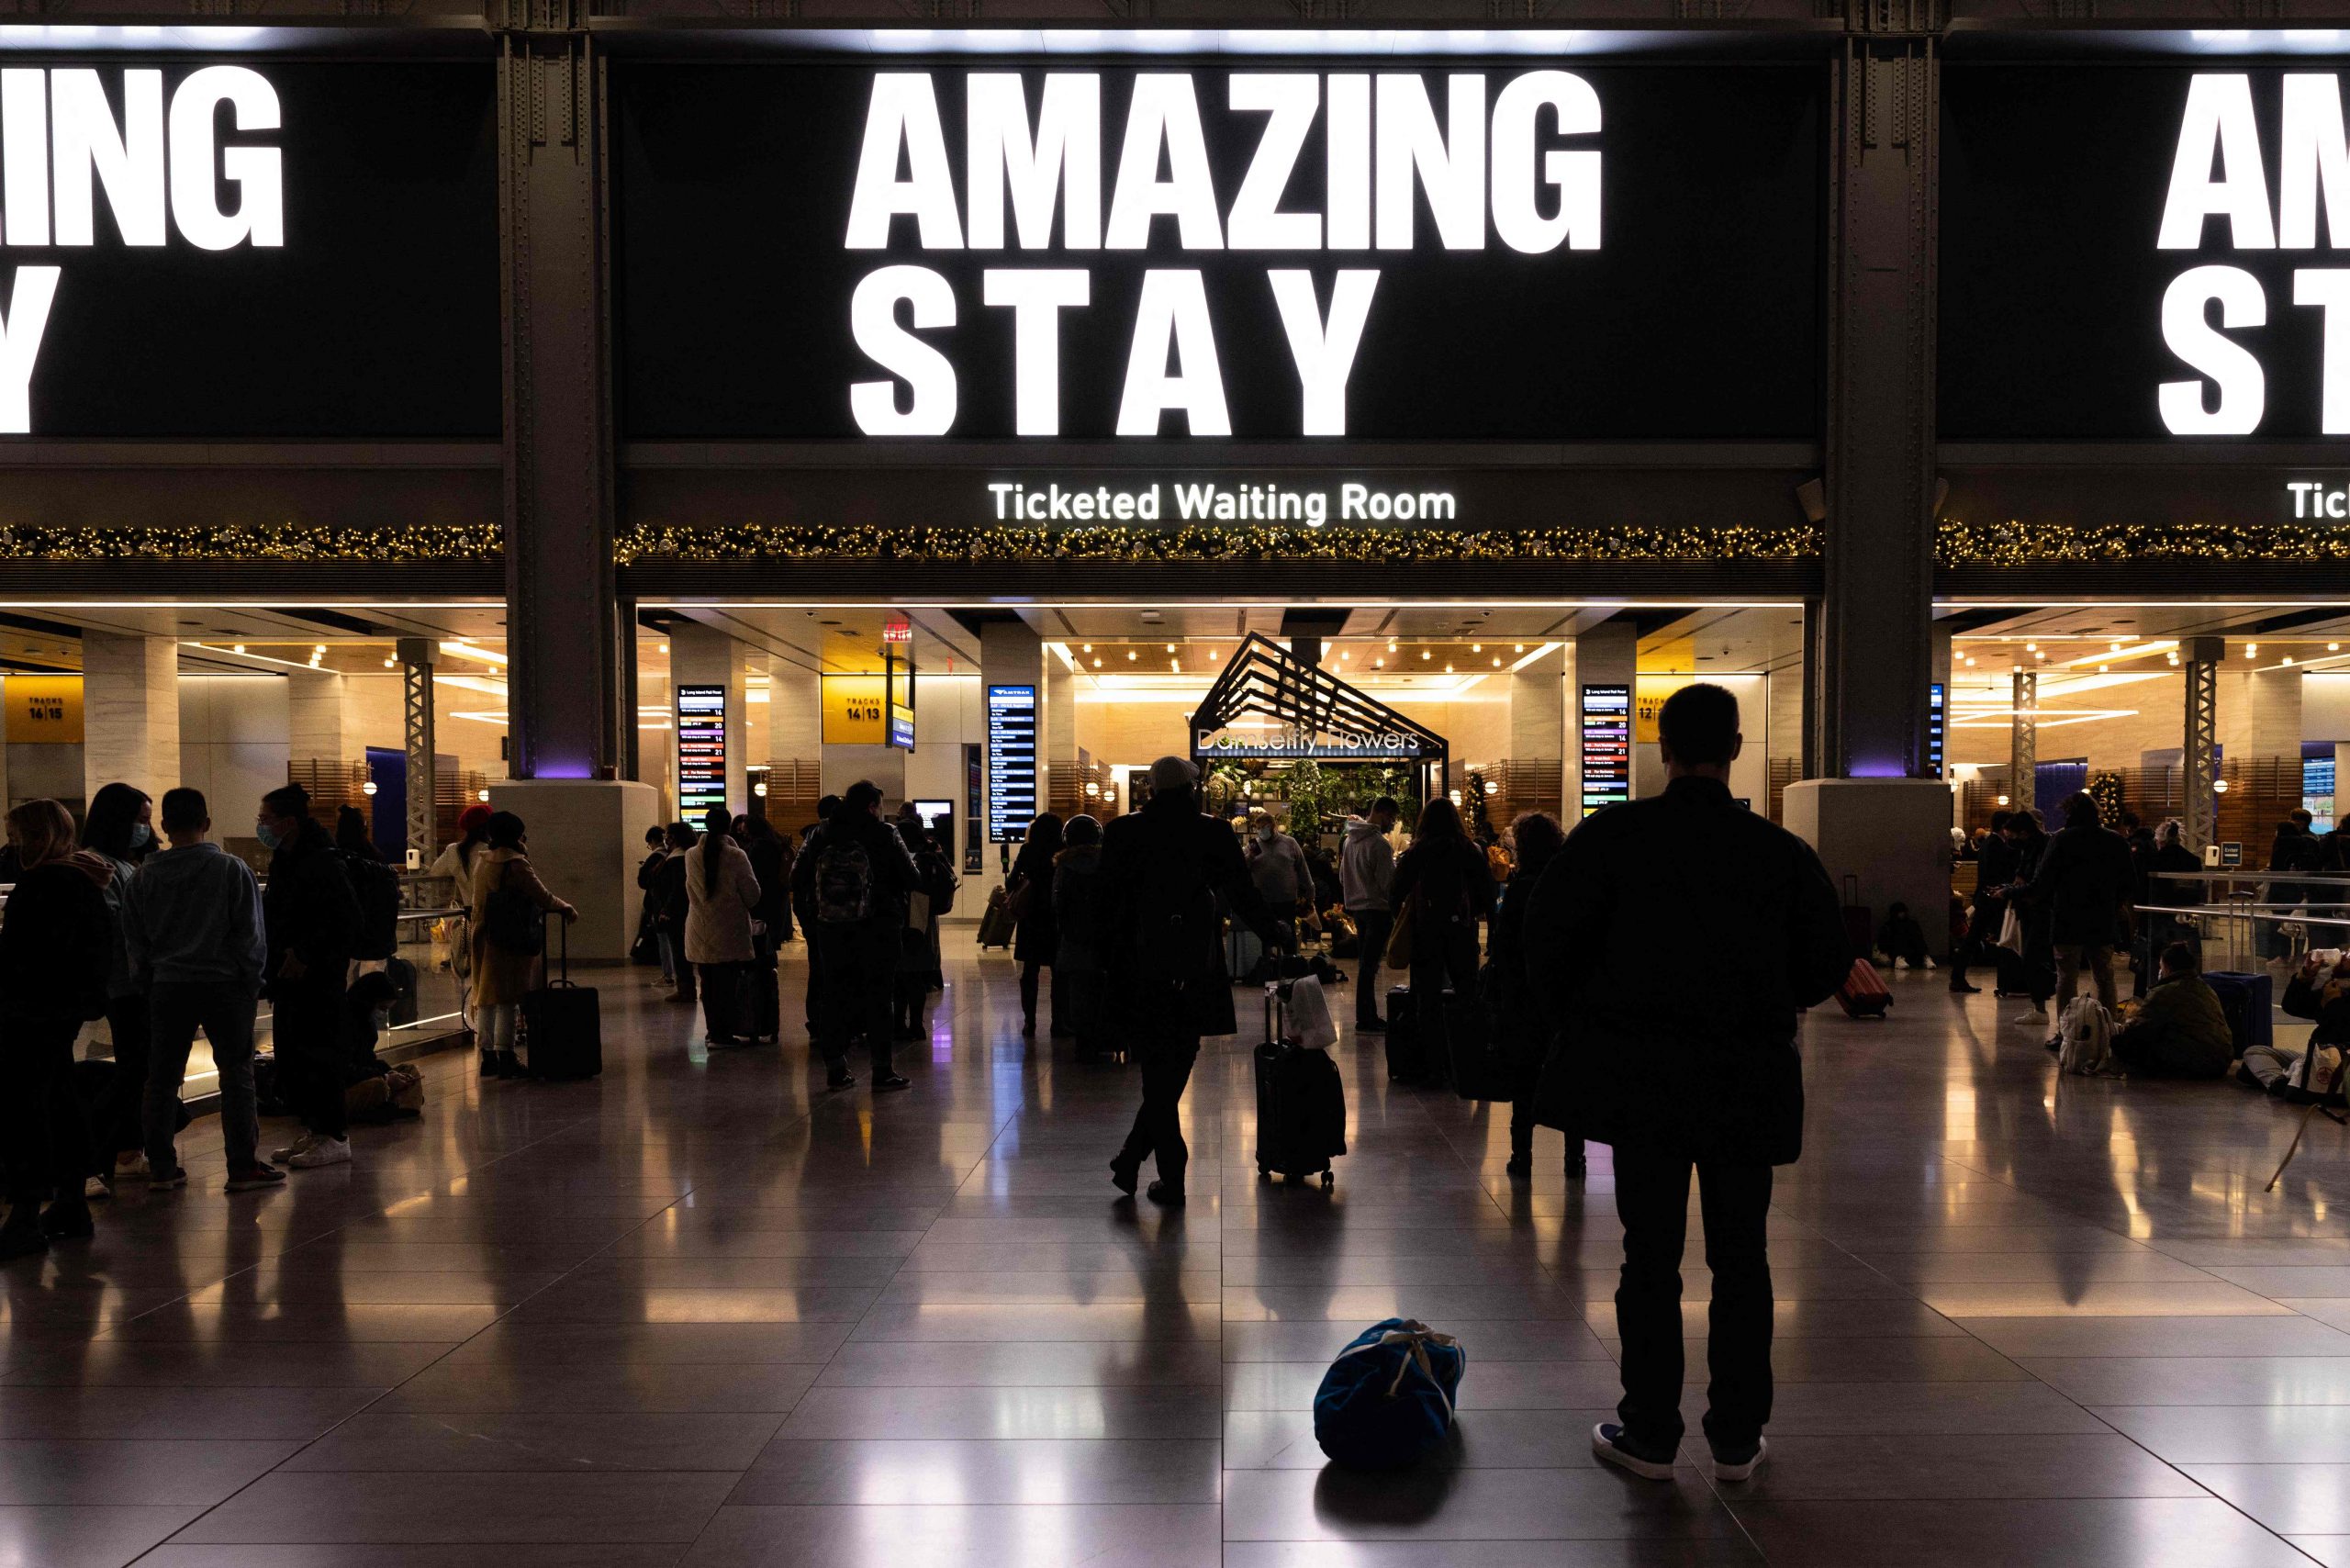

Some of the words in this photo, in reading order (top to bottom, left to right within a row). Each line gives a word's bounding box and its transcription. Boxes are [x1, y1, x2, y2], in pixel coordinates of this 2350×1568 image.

[0, 65, 284, 252] ING
[845, 70, 1604, 254] AMAZING
[850, 265, 1382, 437] STAY
[988, 484, 1159, 520] Ticketed
[1174, 484, 1327, 527] Waiting
[1341, 483, 1456, 520] Room
[2288, 483, 2350, 519] Tic
[29, 697, 62, 705] TRACKS
[1638, 697, 1665, 705] TRACK
[1196, 728, 1318, 755] Damselfly
[1327, 728, 1419, 750] Flowers
